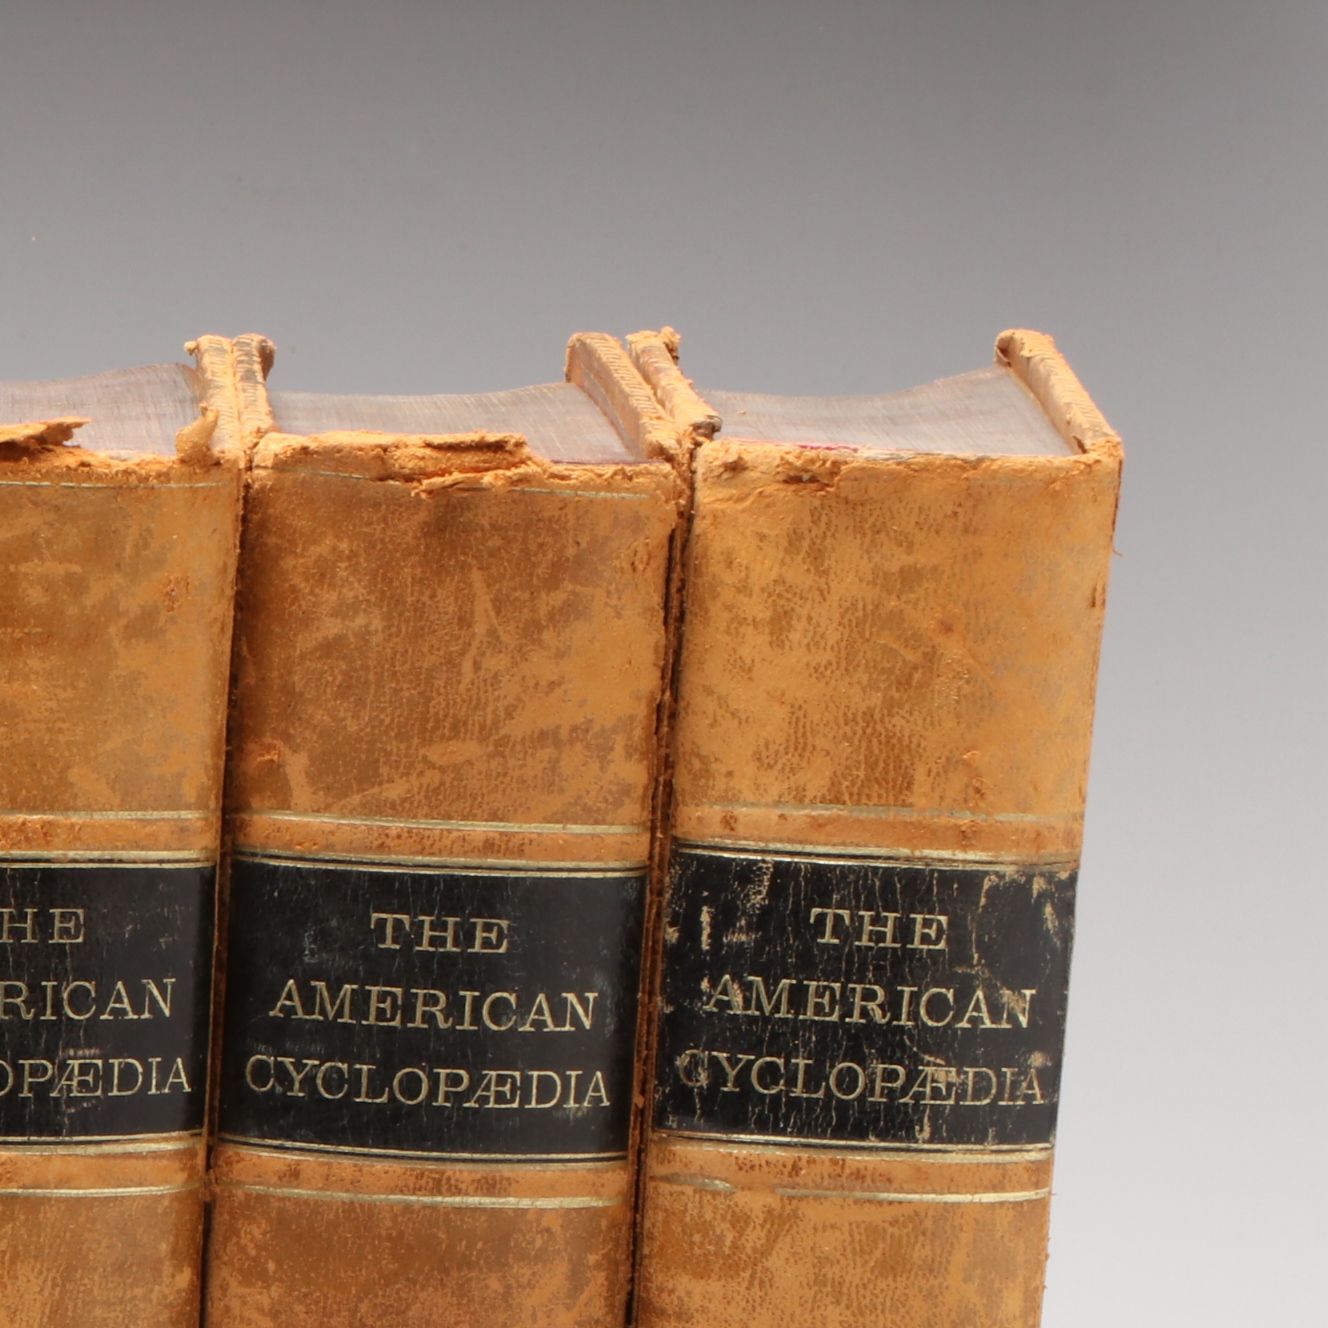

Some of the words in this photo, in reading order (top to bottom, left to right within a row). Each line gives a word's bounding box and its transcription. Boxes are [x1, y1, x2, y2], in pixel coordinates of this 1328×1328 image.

[370, 913, 511, 954] THE
[810, 907, 949, 950] THE
[269, 979, 598, 1032] AMERICAN
[703, 974, 1036, 1029] AMERICAN
